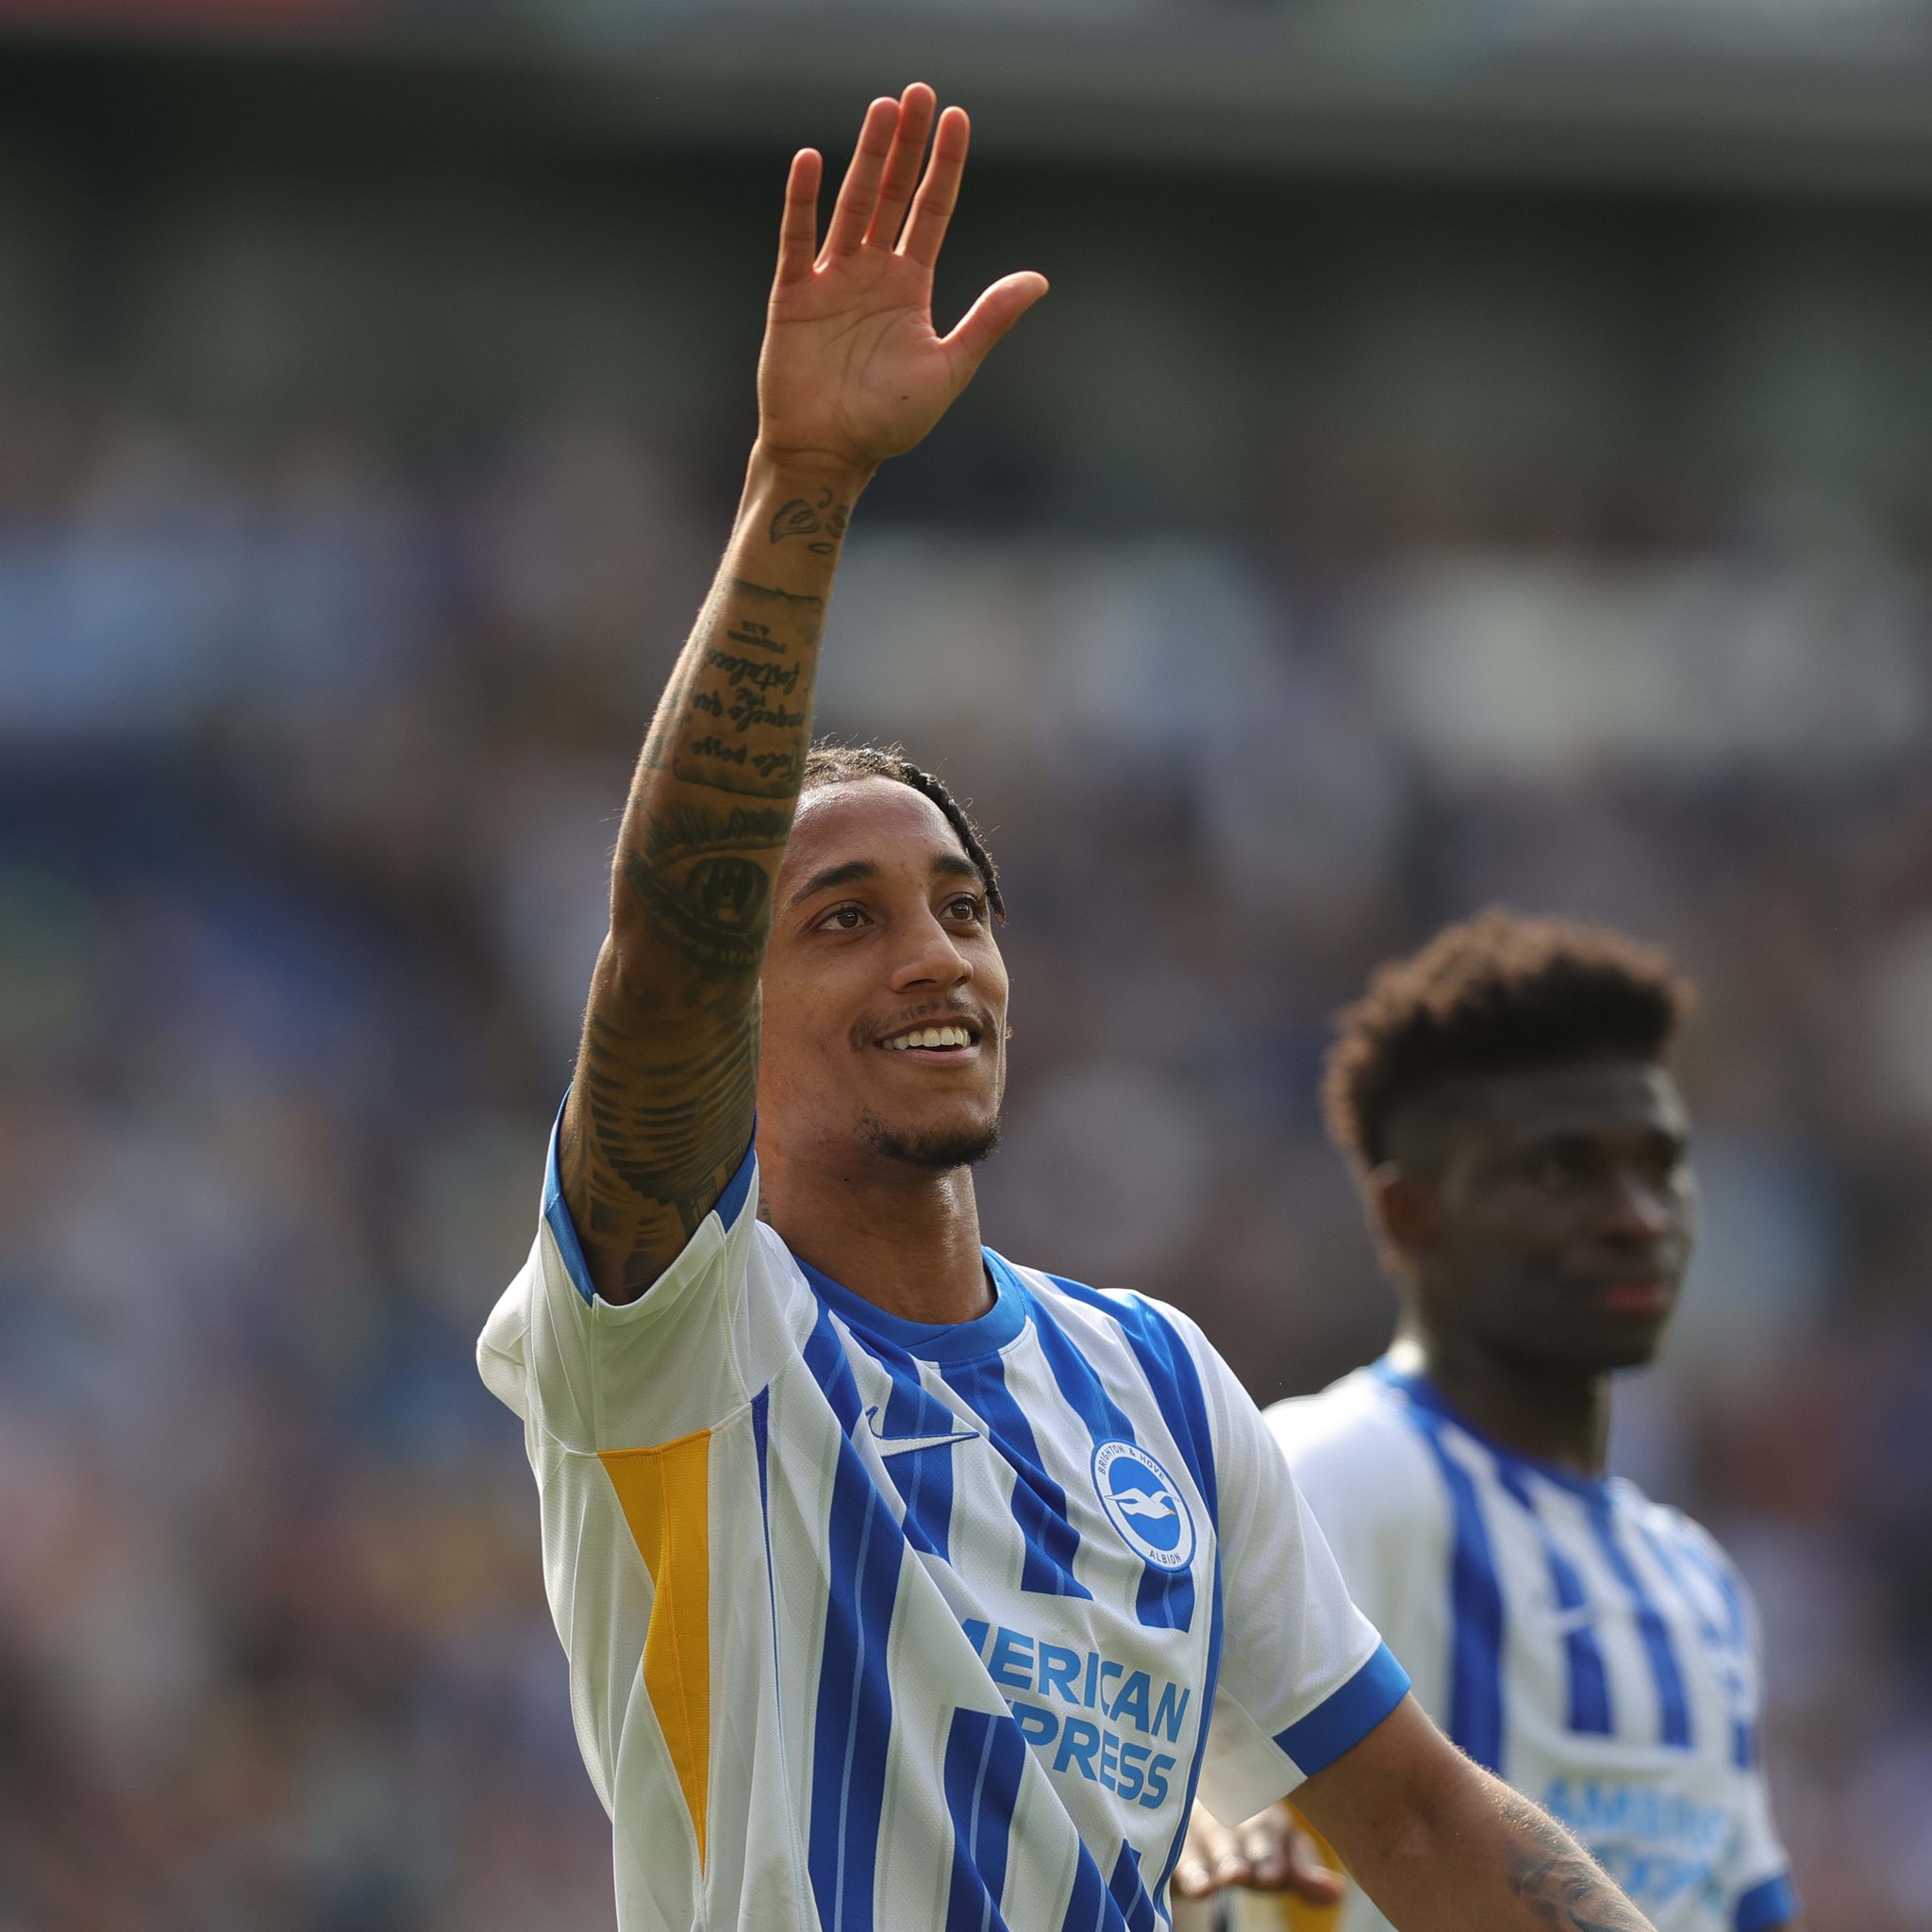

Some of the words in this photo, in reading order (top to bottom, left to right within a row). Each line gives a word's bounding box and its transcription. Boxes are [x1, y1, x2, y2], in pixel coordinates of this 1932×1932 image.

[1098, 1444, 1125, 1475] BRIGHTON
[1140, 1456, 1165, 1480] HOVE
[1149, 1550, 1182, 1564] ALBION
[1004, 1698, 1176, 1809] PRESS
